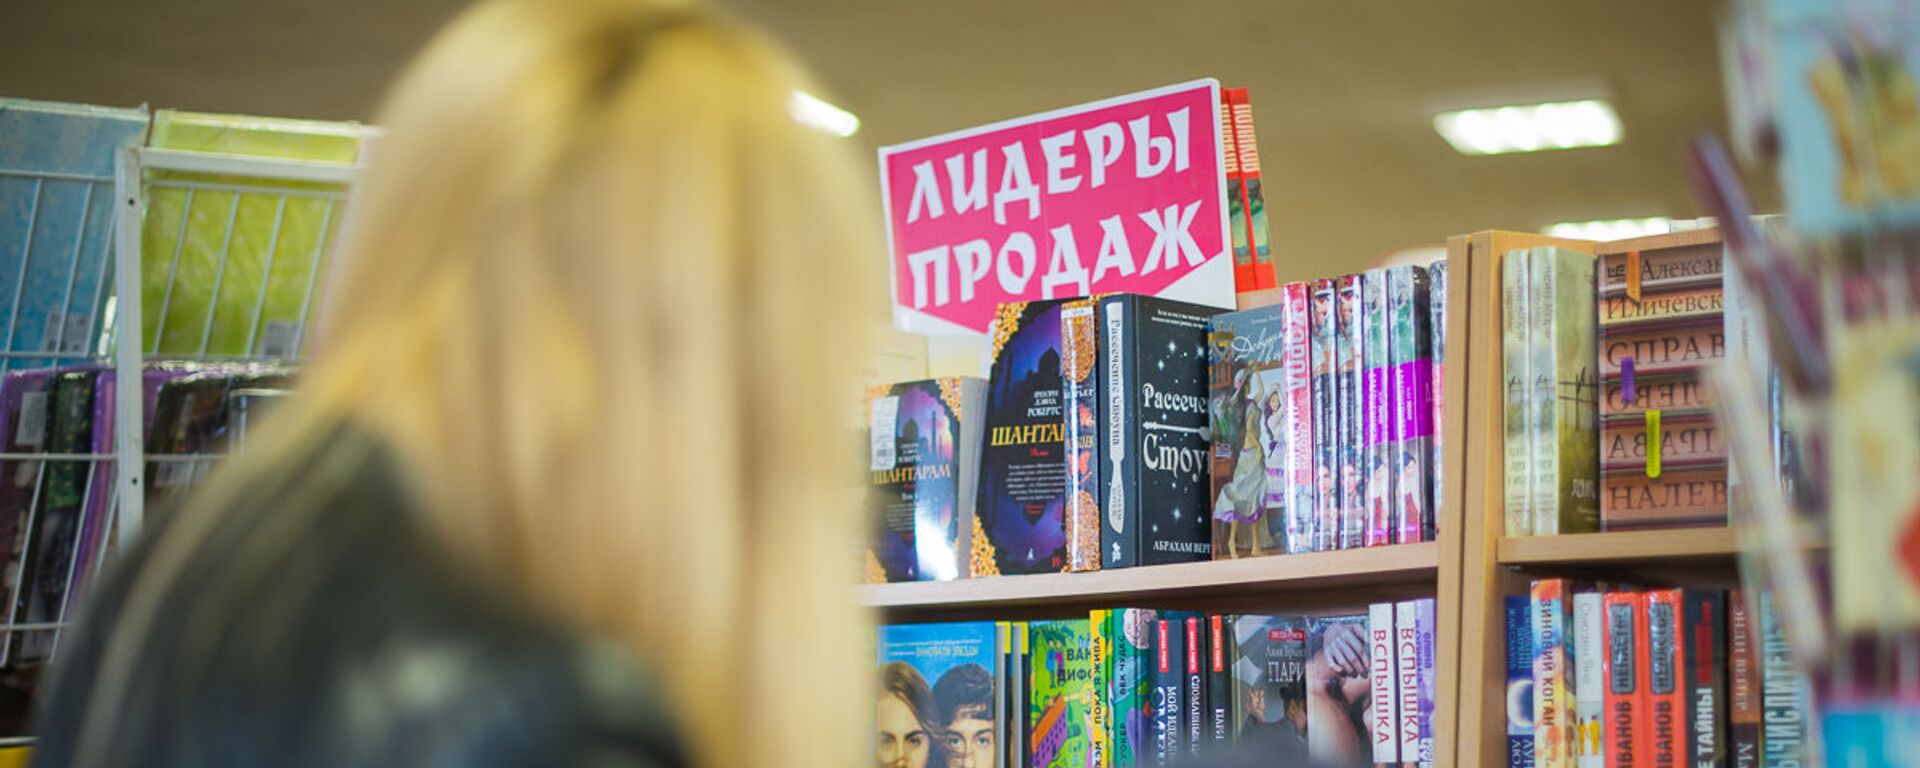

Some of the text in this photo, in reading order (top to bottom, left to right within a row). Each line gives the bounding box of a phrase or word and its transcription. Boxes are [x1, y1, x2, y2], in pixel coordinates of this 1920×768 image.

[906, 106, 1190, 225] ЛИДЕРЫ
[907, 200, 1206, 309] ПРОДАЖ
[1607, 333, 1725, 367] СПРАВ
[1142, 383, 1207, 414] Рассече
[874, 464, 952, 484] ШАНТАРАМ
[1143, 434, 1210, 482] Стоу
[1609, 481, 1728, 510] НАЛЕВ
[1153, 541, 1192, 553] АБРАХАМ
[1093, 636, 1102, 724] ПОКА Я ЖИВА
[1118, 635, 1127, 695] ВЕК ЧУДЕС
[1373, 629, 1390, 745] ВСПЫШКА
[1400, 627, 1419, 744] ВСПЫШКА
[1541, 600, 1555, 726] ЗИНОВИЙ КОГАН
[1167, 686, 1178, 713] МОЙ
[1694, 688, 1713, 756] ТАЙНЫ
